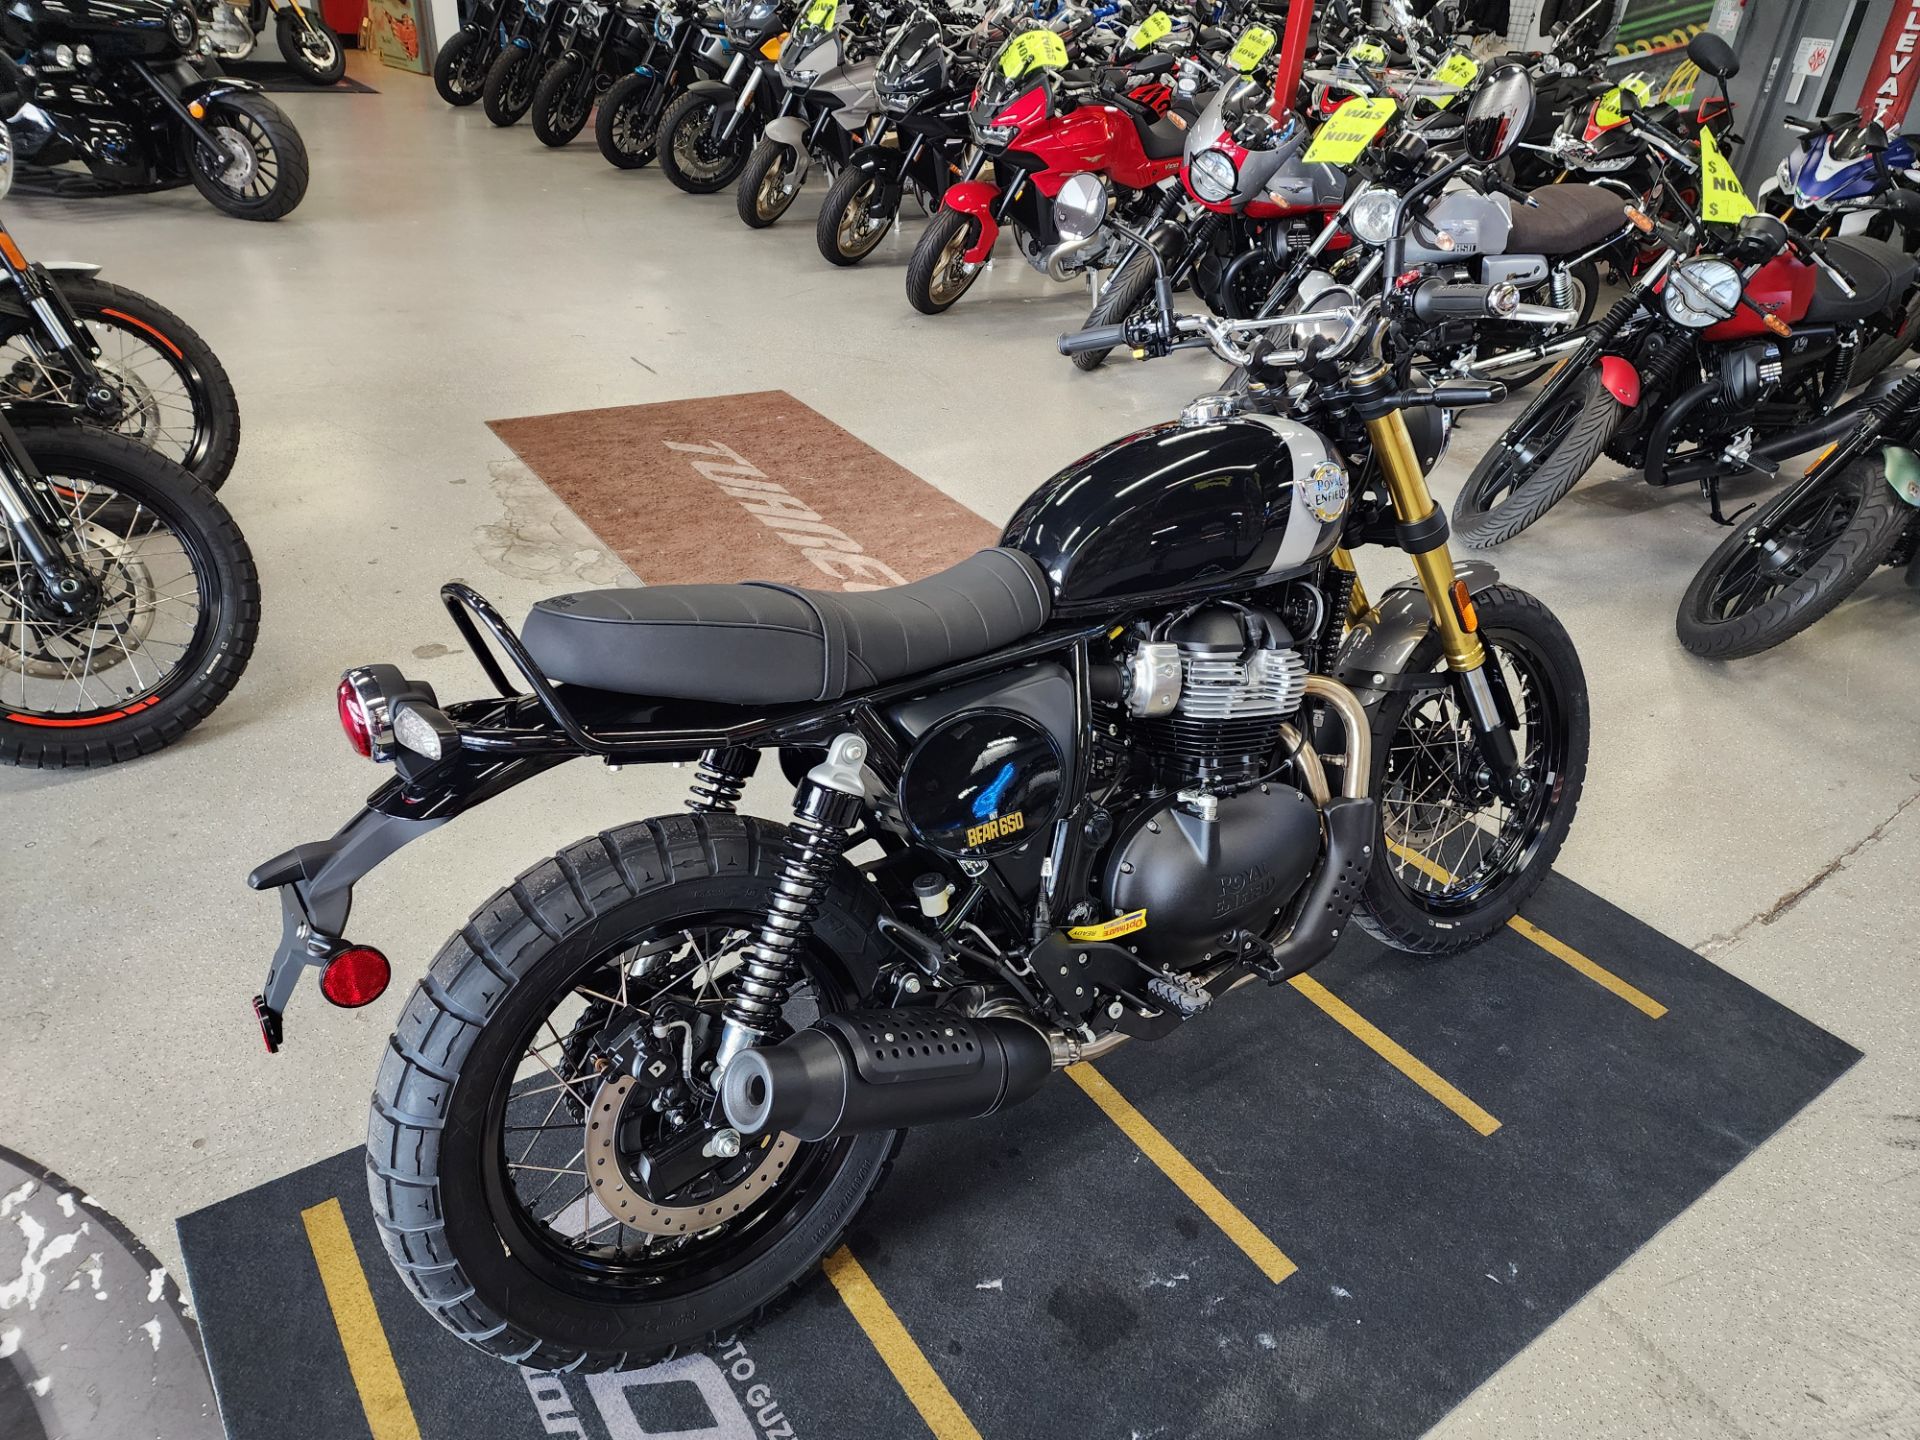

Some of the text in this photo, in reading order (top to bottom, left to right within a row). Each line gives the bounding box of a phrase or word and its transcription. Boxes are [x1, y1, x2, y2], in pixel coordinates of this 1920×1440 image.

[1248, 34, 1268, 47] WAS
[1447, 62, 1470, 79] WAS
[1343, 108, 1385, 120] WAS
[1322, 130, 1366, 143] NOW
[1708, 160, 1718, 174] $
[661, 438, 910, 592] TUARE
[966, 811, 1024, 848] BEAR 650
[746, 1383, 800, 1440] GUZ
